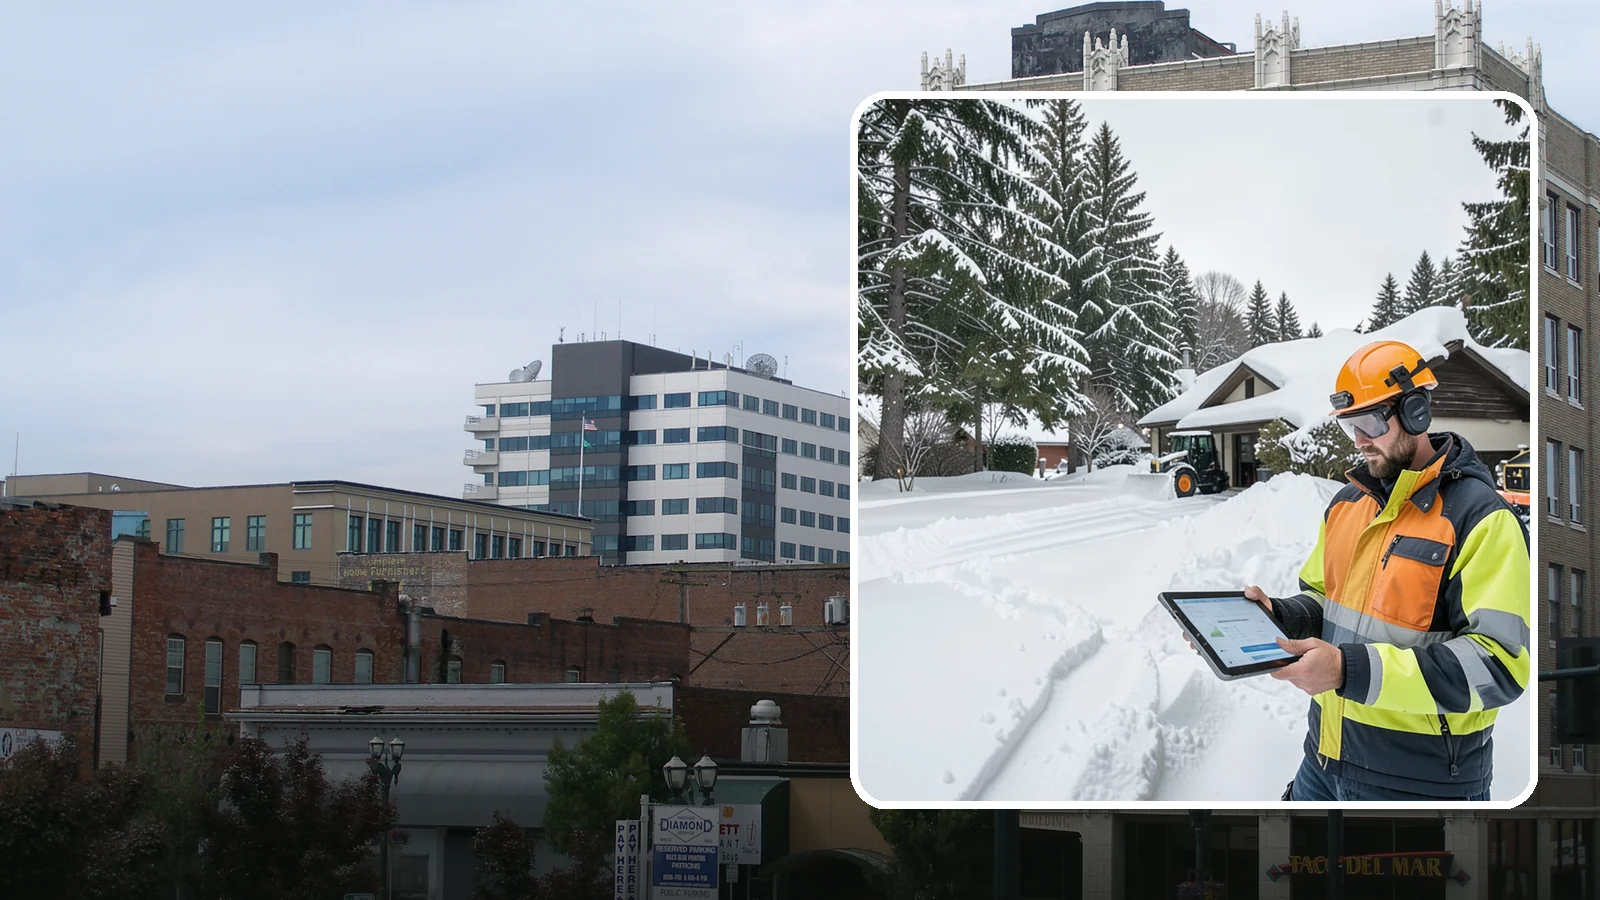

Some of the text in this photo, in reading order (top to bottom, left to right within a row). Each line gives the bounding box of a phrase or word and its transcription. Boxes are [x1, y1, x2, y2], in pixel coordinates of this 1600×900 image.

[370, 566, 427, 576] Furnishers
[660, 818, 713, 832] DIAMOND
[1022, 815, 1069, 828] BUILDING
[656, 845, 716, 854] RESERVED PARKING
[616, 825, 625, 894] PAY HERE
[627, 824, 637, 894] PAY HERE
[722, 852, 739, 862] Soup
[1346, 856, 1385, 875] DEL
[1392, 857, 1442, 877] MAR
[660, 888, 710, 898] PUBLIC PARKING
